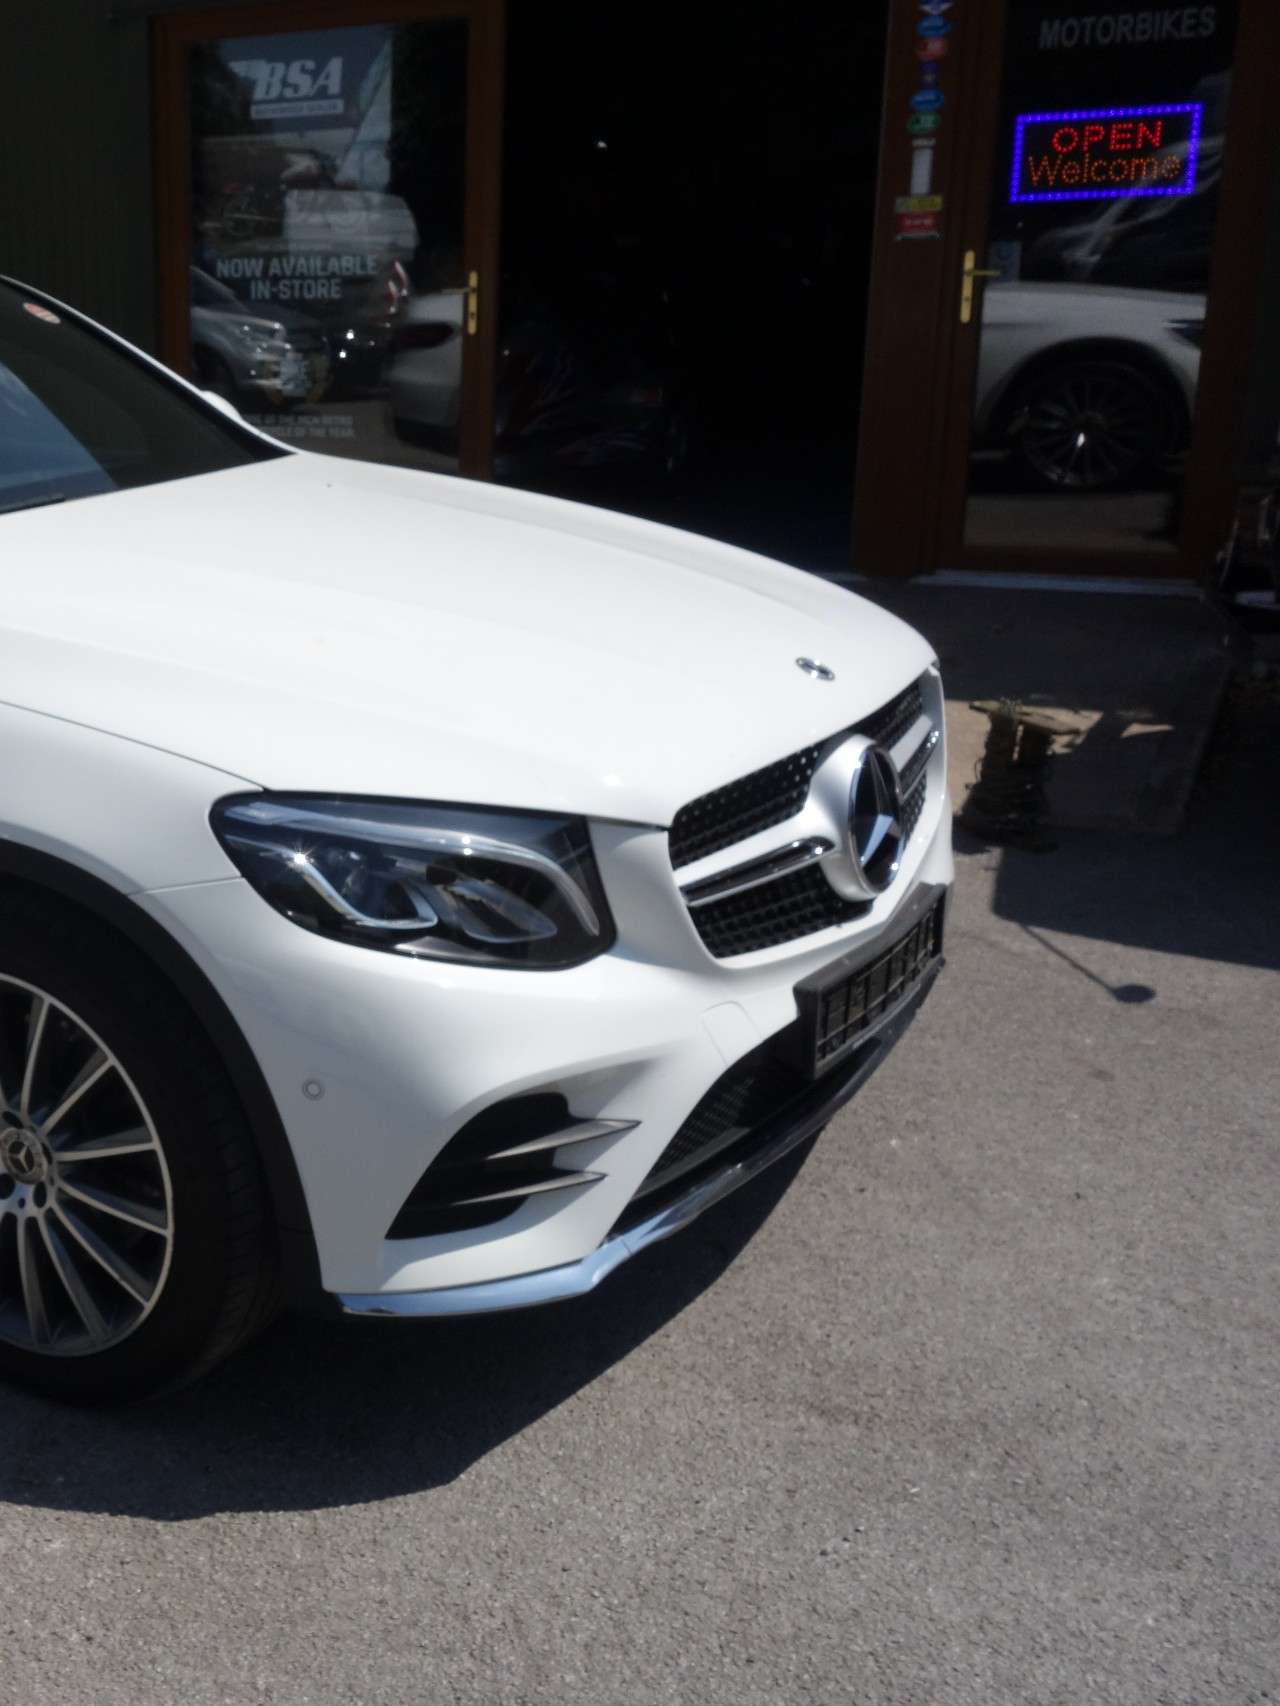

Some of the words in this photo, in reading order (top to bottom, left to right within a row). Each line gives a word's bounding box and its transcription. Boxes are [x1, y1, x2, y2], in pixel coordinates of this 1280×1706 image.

[1040, 5, 1217, 48] MOTORBIKES
[250, 56, 343, 99] BSA
[1051, 120, 1163, 154] OPEN
[1026, 153, 1181, 187] Welcome
[216, 256, 264, 278] NOW
[268, 254, 378, 277] AVAILABLE
[250, 277, 343, 300] IN-STORE
